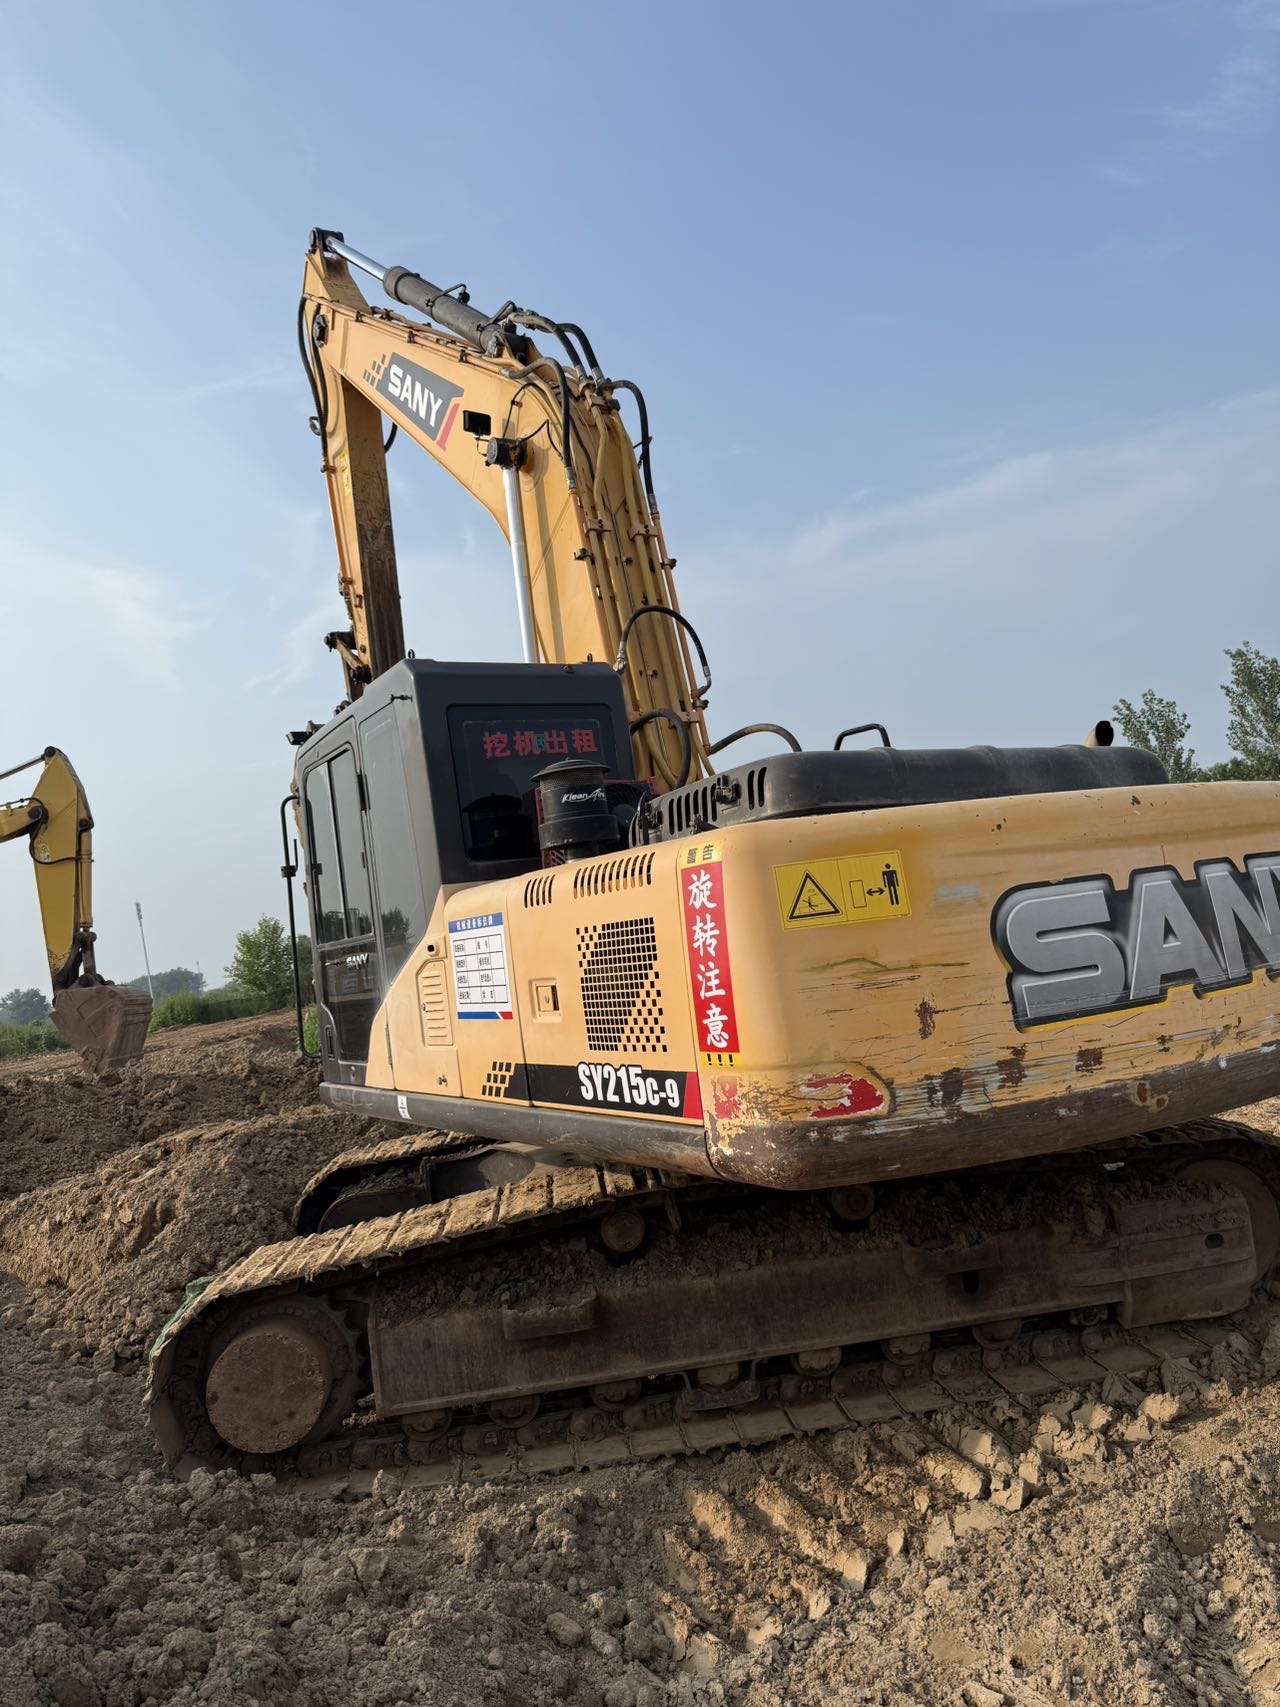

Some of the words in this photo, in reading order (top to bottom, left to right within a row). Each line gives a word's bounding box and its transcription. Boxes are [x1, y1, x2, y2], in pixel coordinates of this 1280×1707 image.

[388, 364, 443, 428] SANY
[483, 728, 598, 760] 挖机出租
[687, 844, 715, 864] 警告
[687, 869, 731, 1049] 旋转注意
[1006, 864, 1280, 1018] SAN
[577, 1063, 680, 1109] SY215C-9
